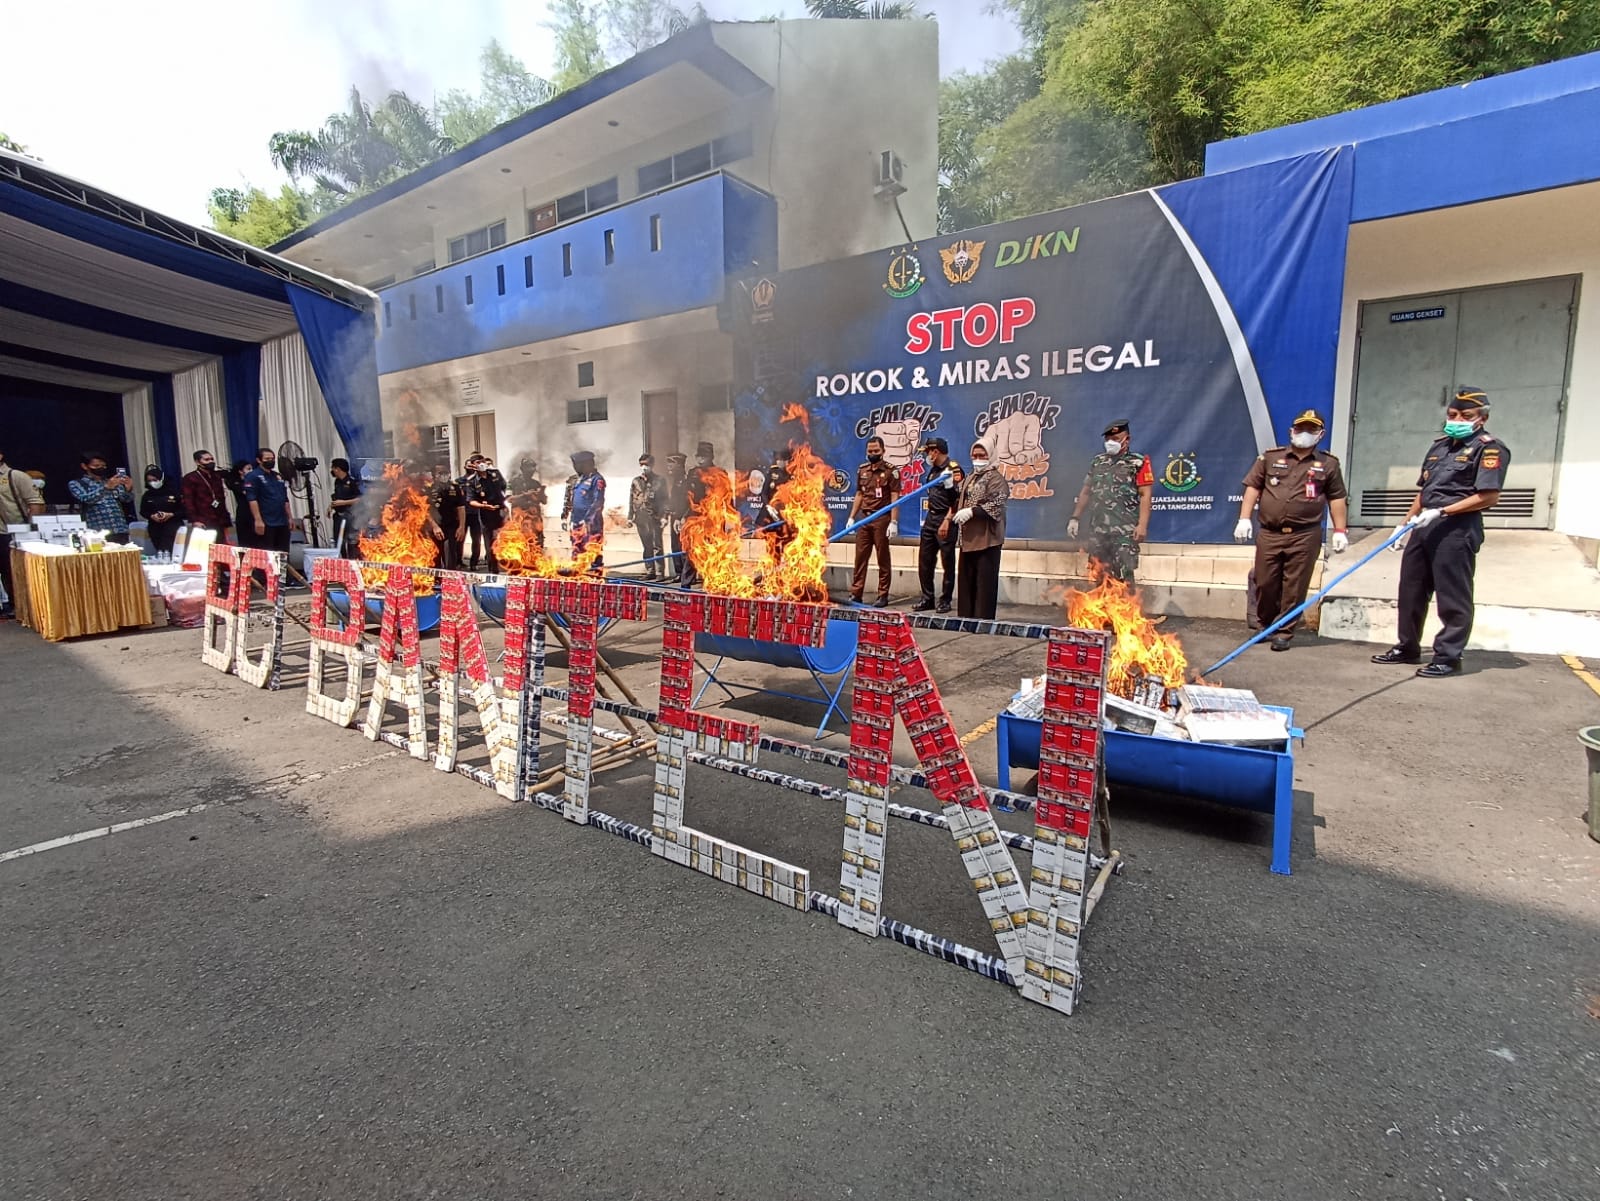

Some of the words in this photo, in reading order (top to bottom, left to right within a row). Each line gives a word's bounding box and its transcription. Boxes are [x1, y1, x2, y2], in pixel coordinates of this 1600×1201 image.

[904, 297, 1036, 355] STOP
[1391, 312, 1415, 321] RUANG
[1416, 309, 1443, 318] GENSET
[815, 367, 904, 398] ROKOK
[911, 366, 931, 389] &
[938, 353, 1032, 388] MIRAS
[1041, 339, 1161, 378] ILEGAL
[855, 401, 943, 439] GEMPUR
[975, 391, 1061, 438] GEMPUR
[999, 453, 1050, 480] IRAS
